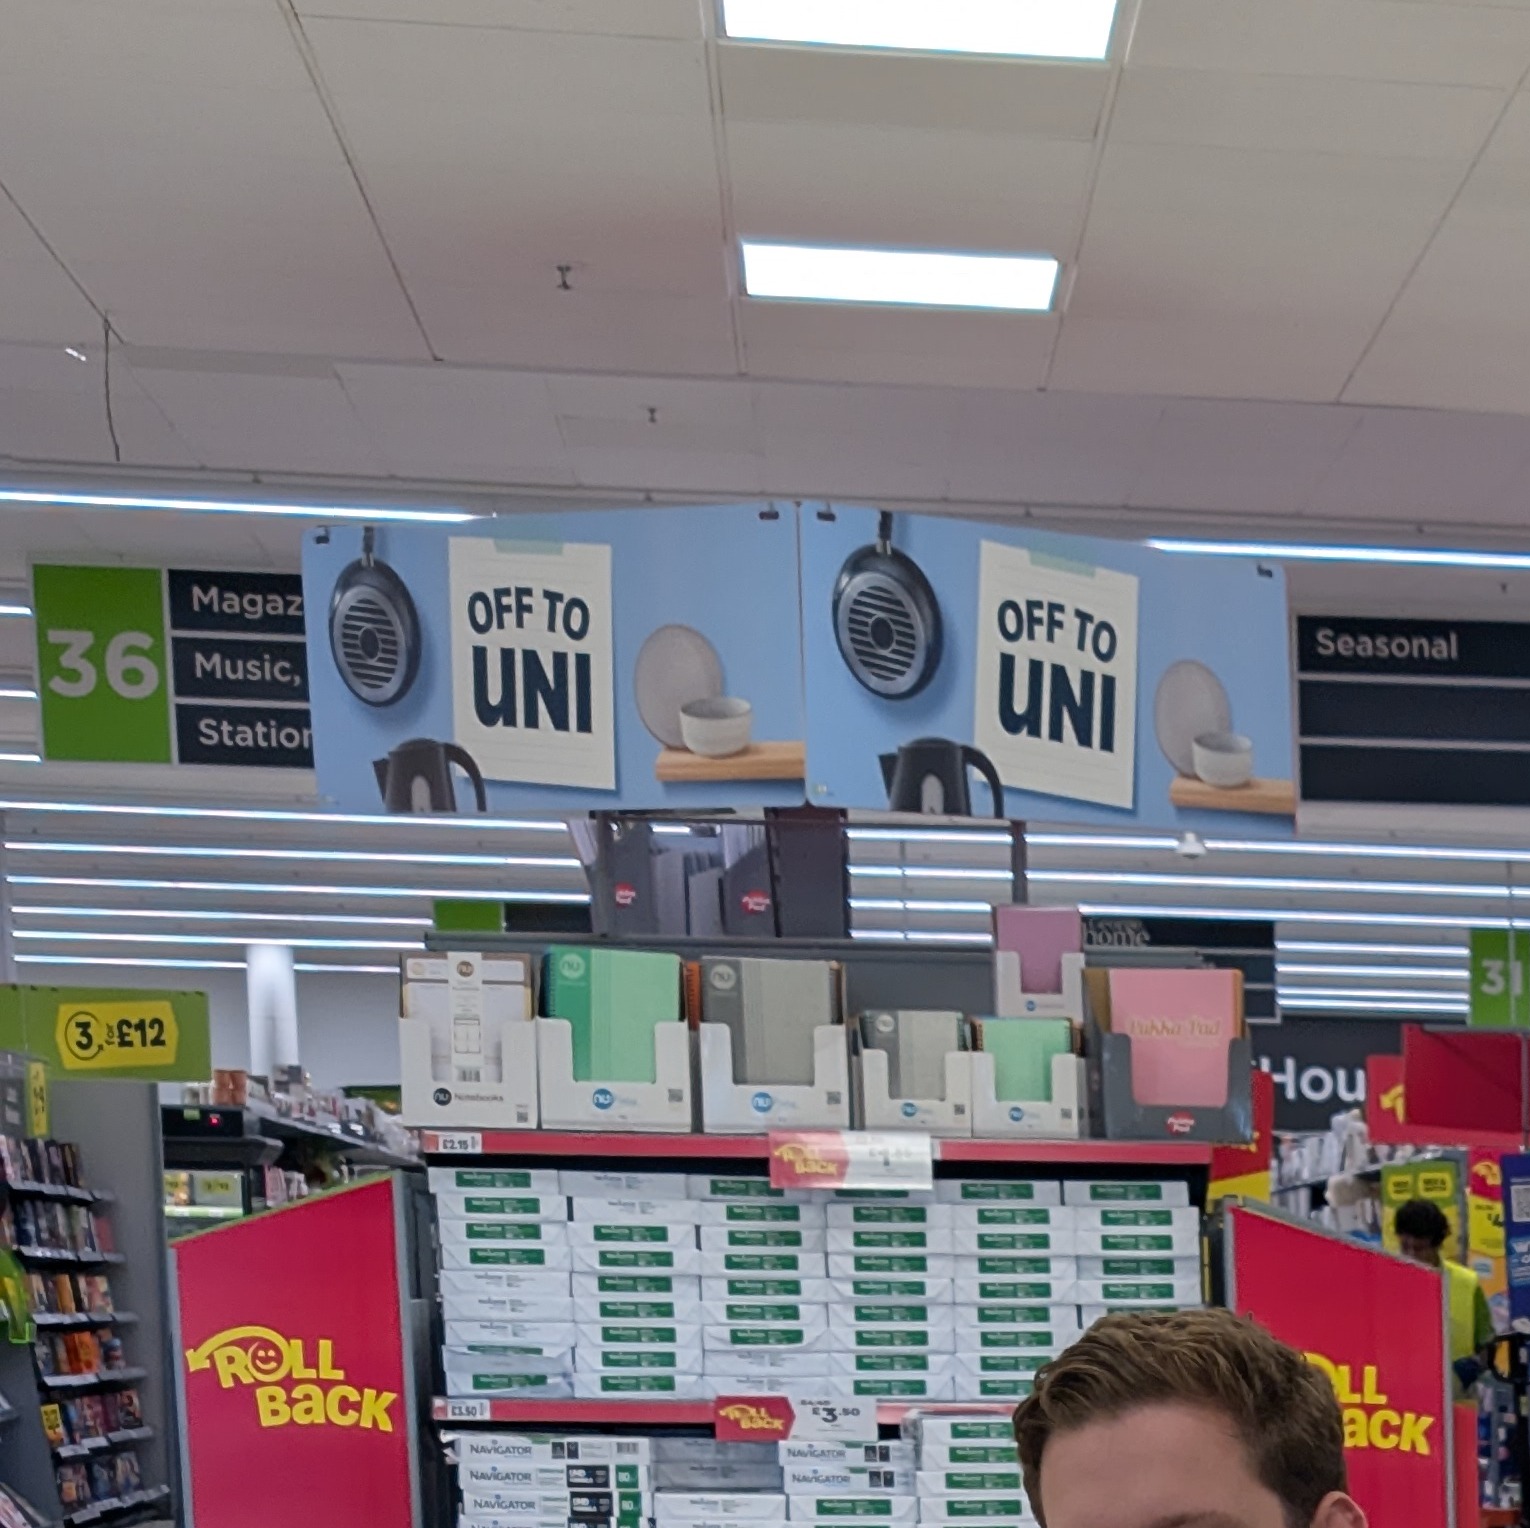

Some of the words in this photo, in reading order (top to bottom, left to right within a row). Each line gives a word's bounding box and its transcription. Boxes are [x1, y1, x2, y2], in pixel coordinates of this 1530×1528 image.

[466, 586, 534, 635] OFF
[546, 588, 591, 638] TO
[997, 599, 1065, 645] OFF
[1075, 610, 1118, 663] TO
[47, 629, 160, 699] 36
[1315, 629, 1459, 661] Seasonal
[194, 652, 302, 686] Music,
[471, 646, 593, 734] UNI
[998, 653, 1117, 754] UNI
[75, 1021, 94, 1050] 3
[117, 1018, 167, 1048] £12
[190, 1327, 345, 1388] ROLL
[469, 1443, 533, 1455] NAVIGATOR
[469, 1470, 532, 1481] NAVIGATOR
[473, 1498, 536, 1511] NAVIGATOR
